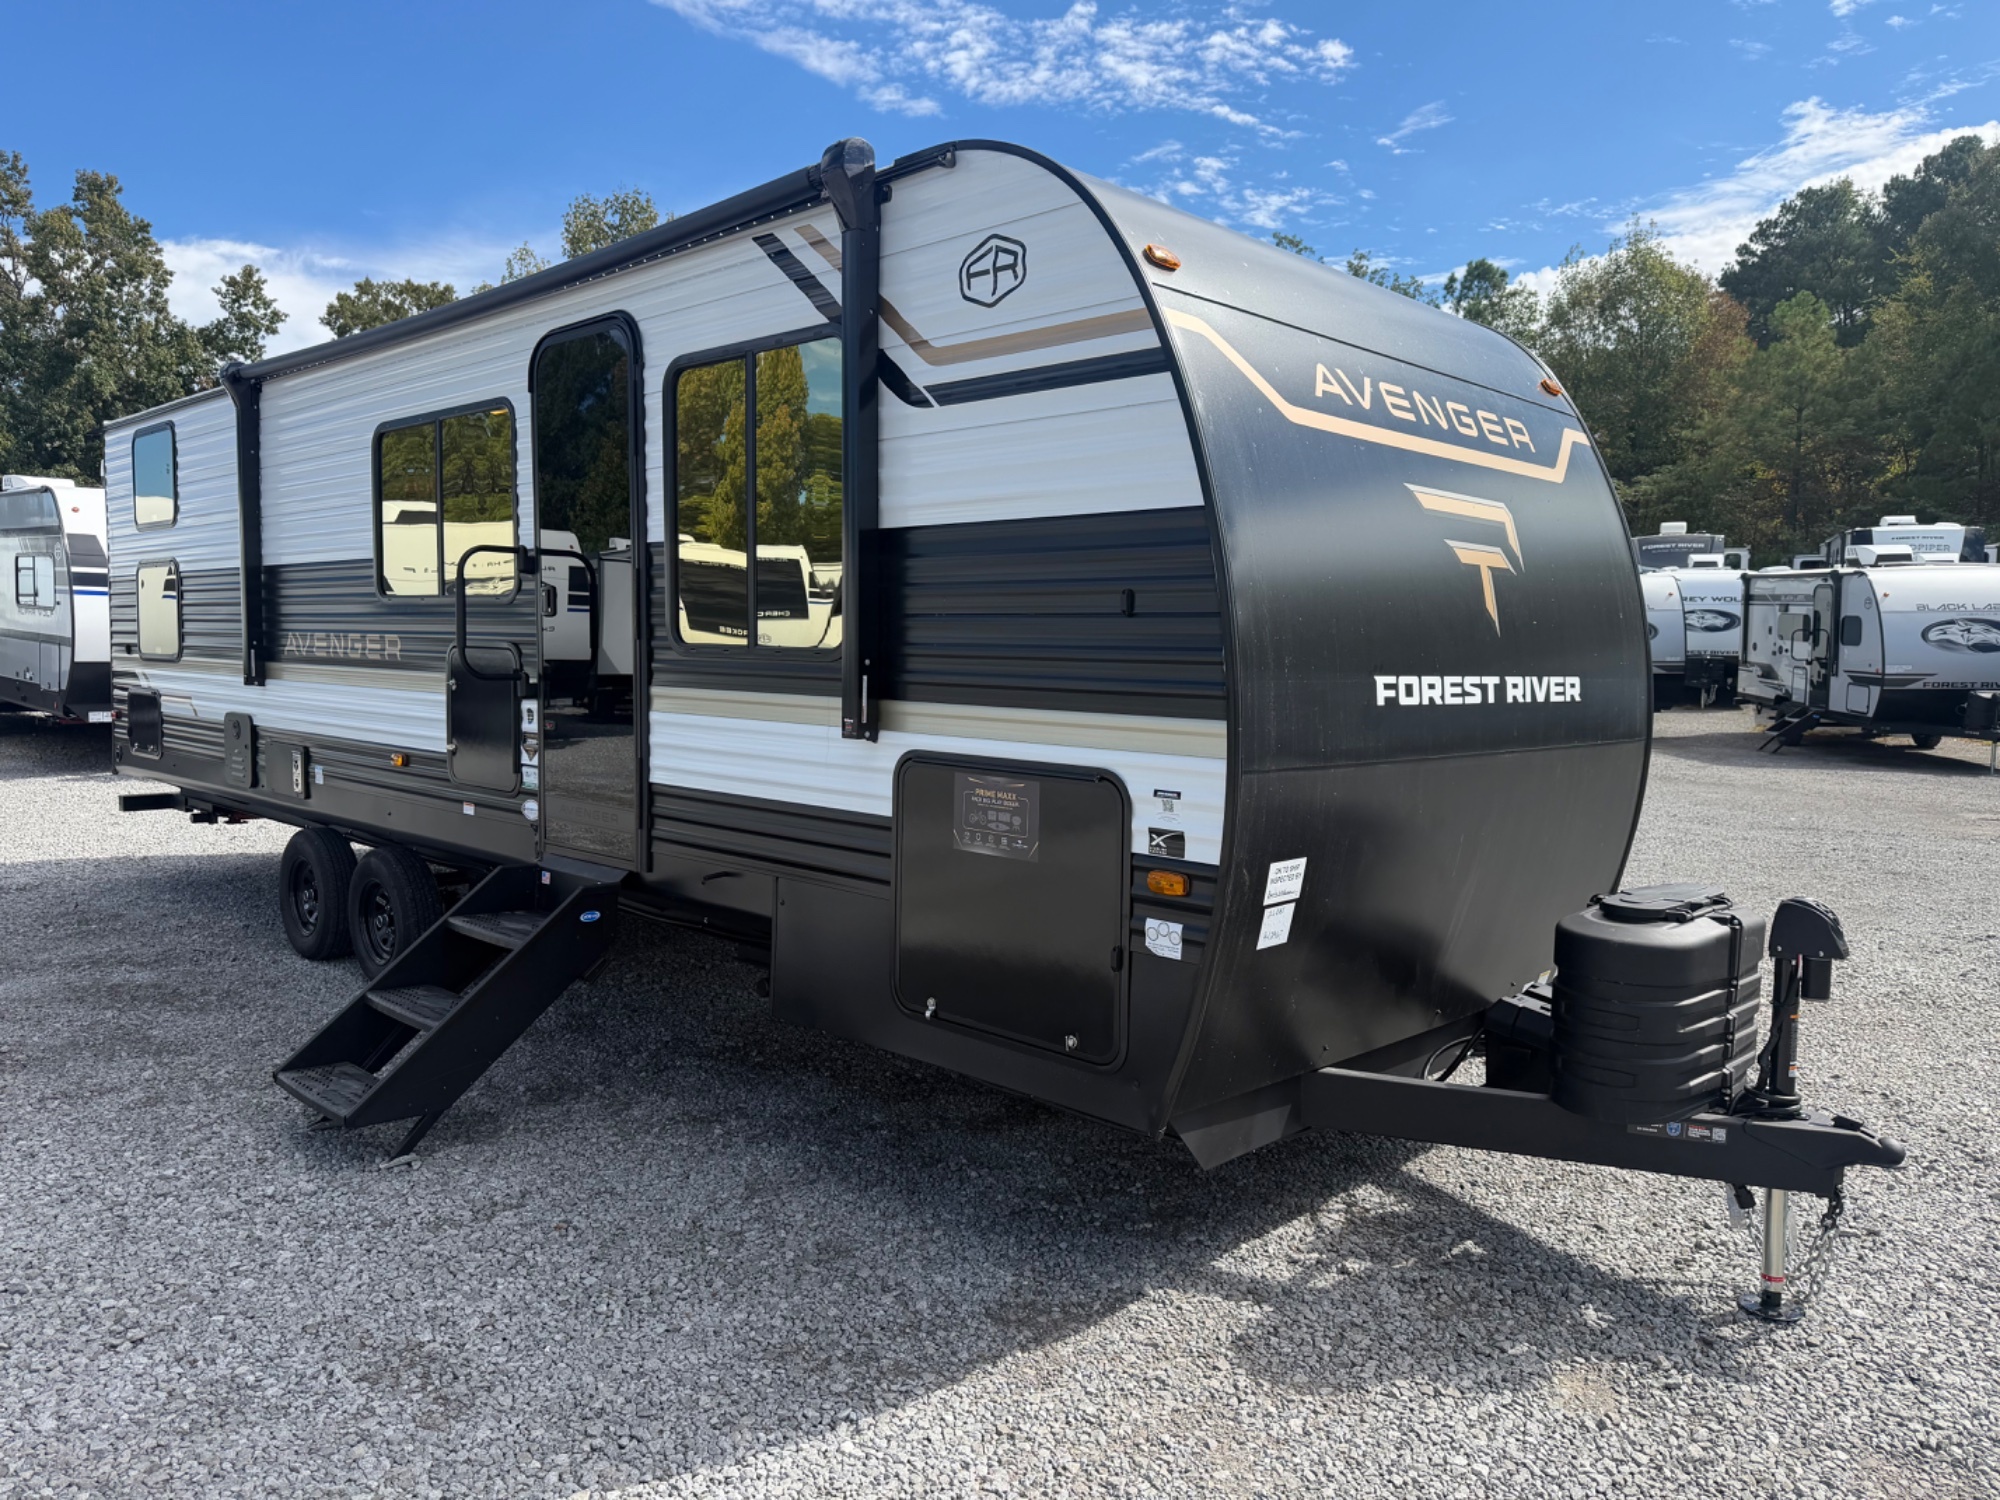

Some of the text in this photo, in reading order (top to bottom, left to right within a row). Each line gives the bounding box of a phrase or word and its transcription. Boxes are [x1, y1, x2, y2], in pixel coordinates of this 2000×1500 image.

[1315, 362, 1536, 454] AVENGER
[1642, 543, 1676, 551] FOREST
[1916, 603, 1967, 611] BLACK
[285, 632, 402, 661] AVENGER
[1374, 675, 1582, 707] FOREST RIVER
[559, 804, 619, 824] AVENGER
[1270, 873, 1295, 885] INSPECTED
